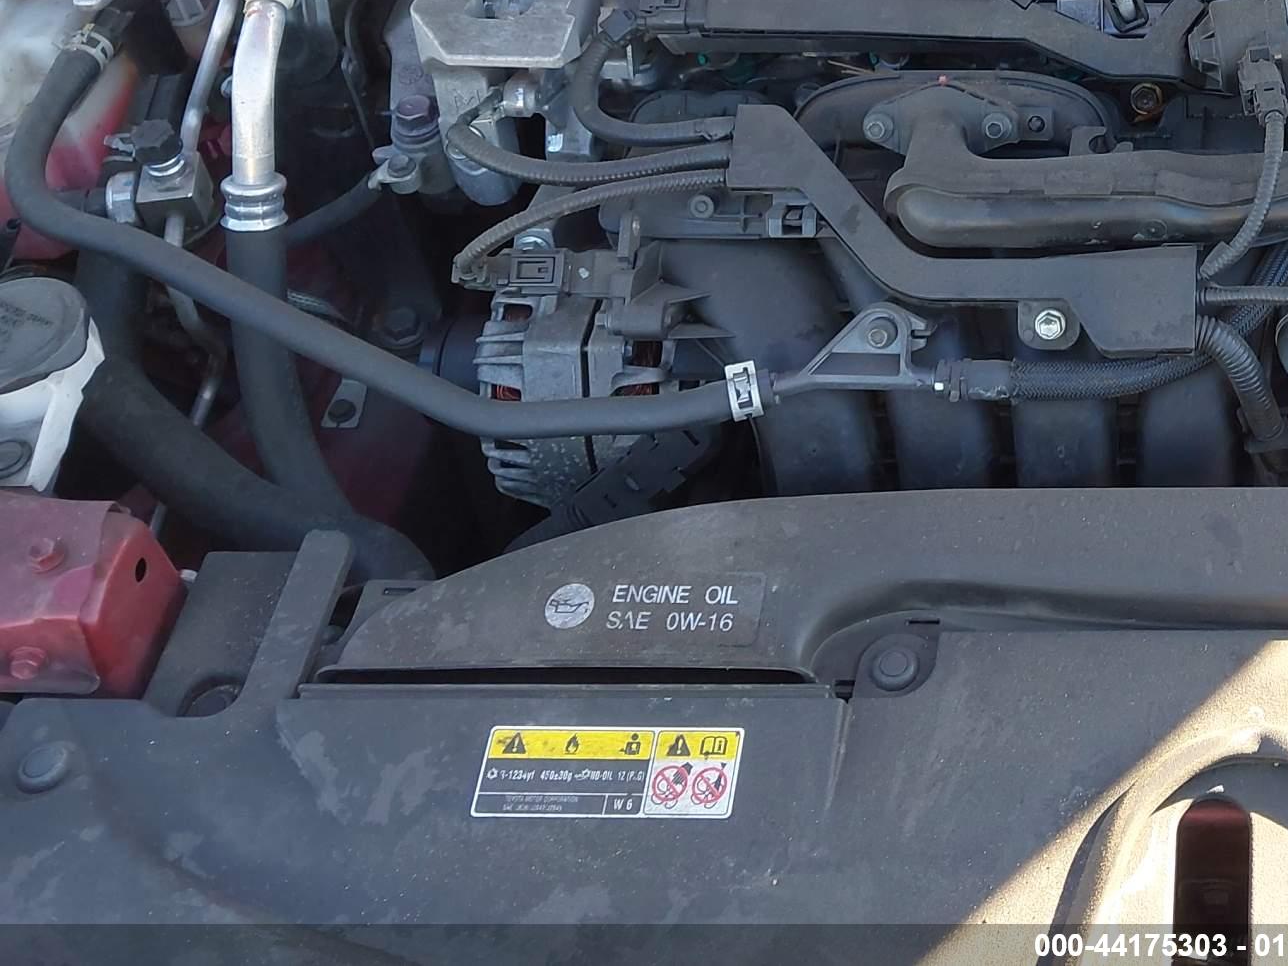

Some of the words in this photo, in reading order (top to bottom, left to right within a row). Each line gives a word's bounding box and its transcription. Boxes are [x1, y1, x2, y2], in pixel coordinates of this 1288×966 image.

[612, 584, 692, 604] ENGINE
[704, 585, 739, 605] OIL
[605, 610, 652, 630] SAE
[666, 611, 734, 632] 0W-16
[626, 769, 645, 782] (PG)
